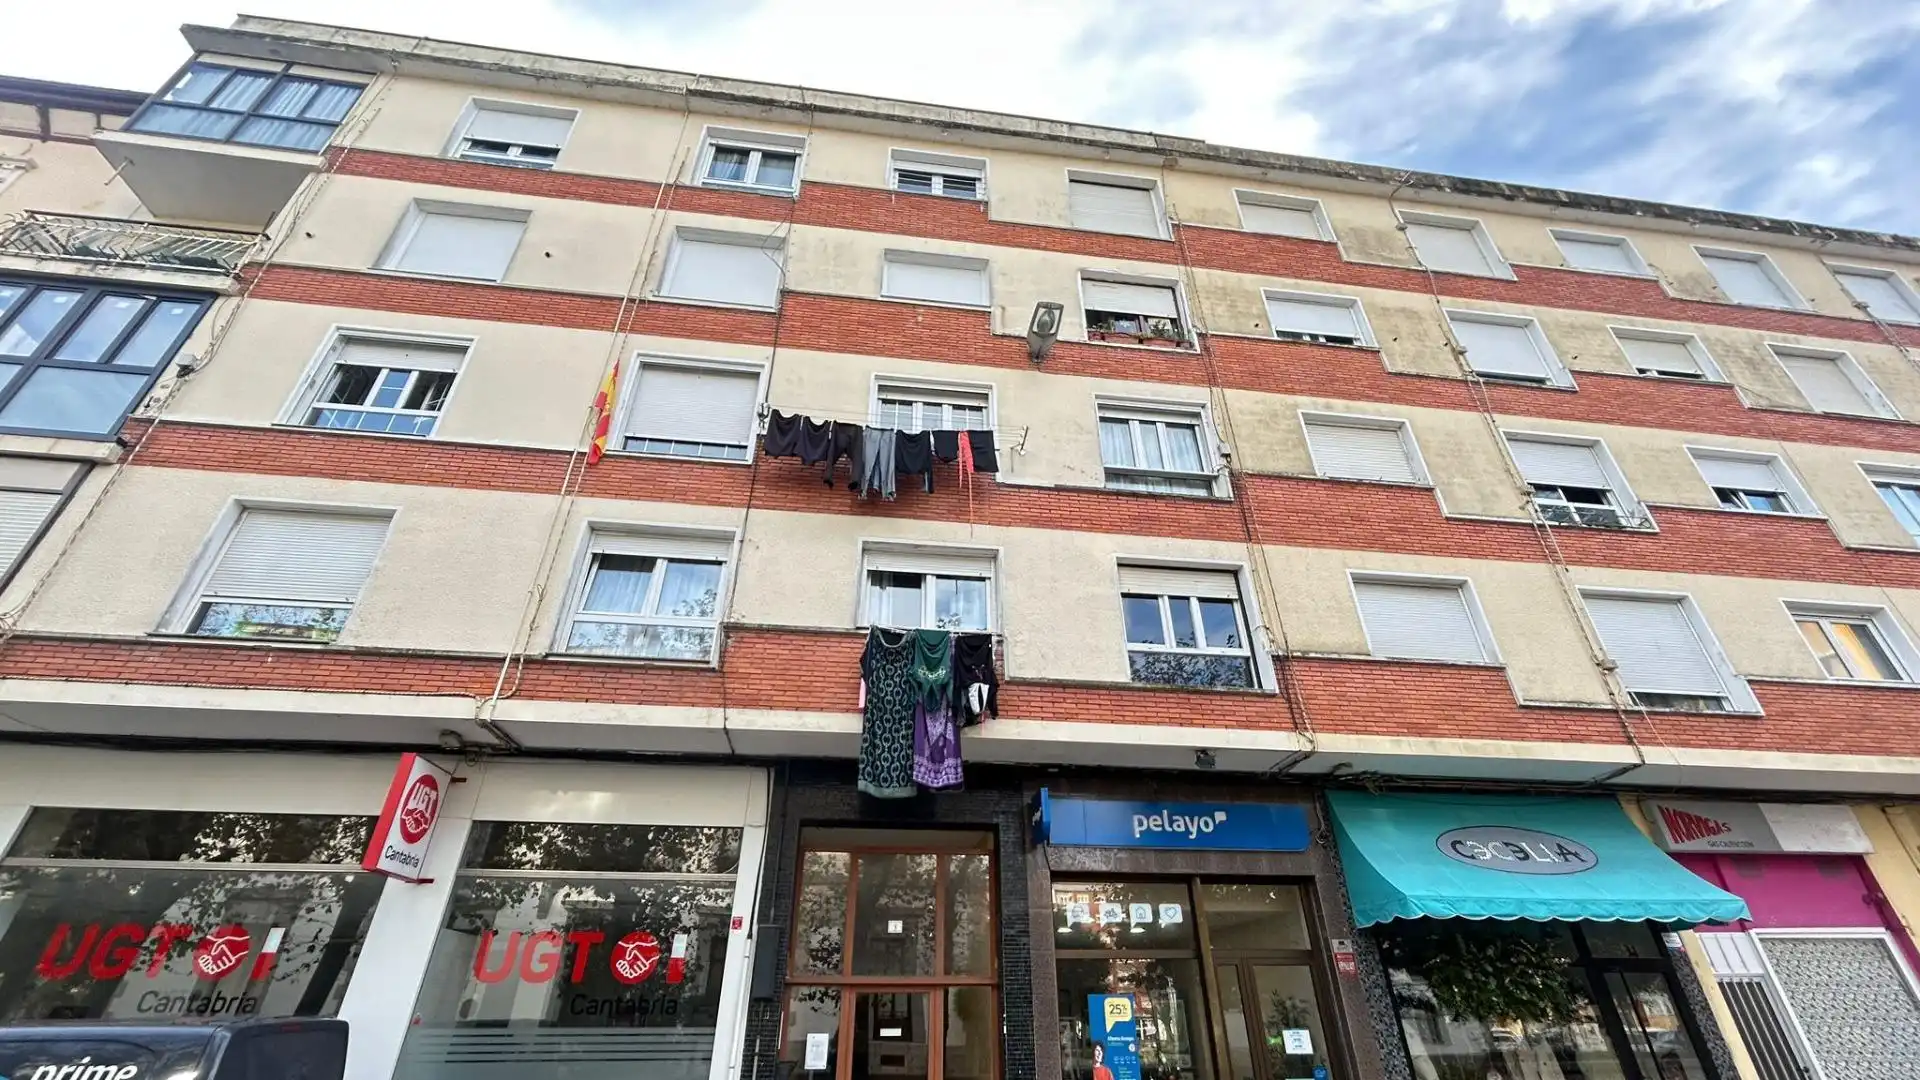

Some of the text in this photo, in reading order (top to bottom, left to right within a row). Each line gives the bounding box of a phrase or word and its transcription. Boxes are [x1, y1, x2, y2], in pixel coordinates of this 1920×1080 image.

[406, 783, 438, 817] UGT
[1132, 809, 1214, 839] pelayo
[385, 845, 419, 868] Cantabria
[34, 923, 193, 980] UGT
[472, 929, 605, 984] UGT
[136, 990, 257, 1014] Cantabria
[569, 994, 679, 1016] Cantabria
[30, 1056, 138, 1080] prime
